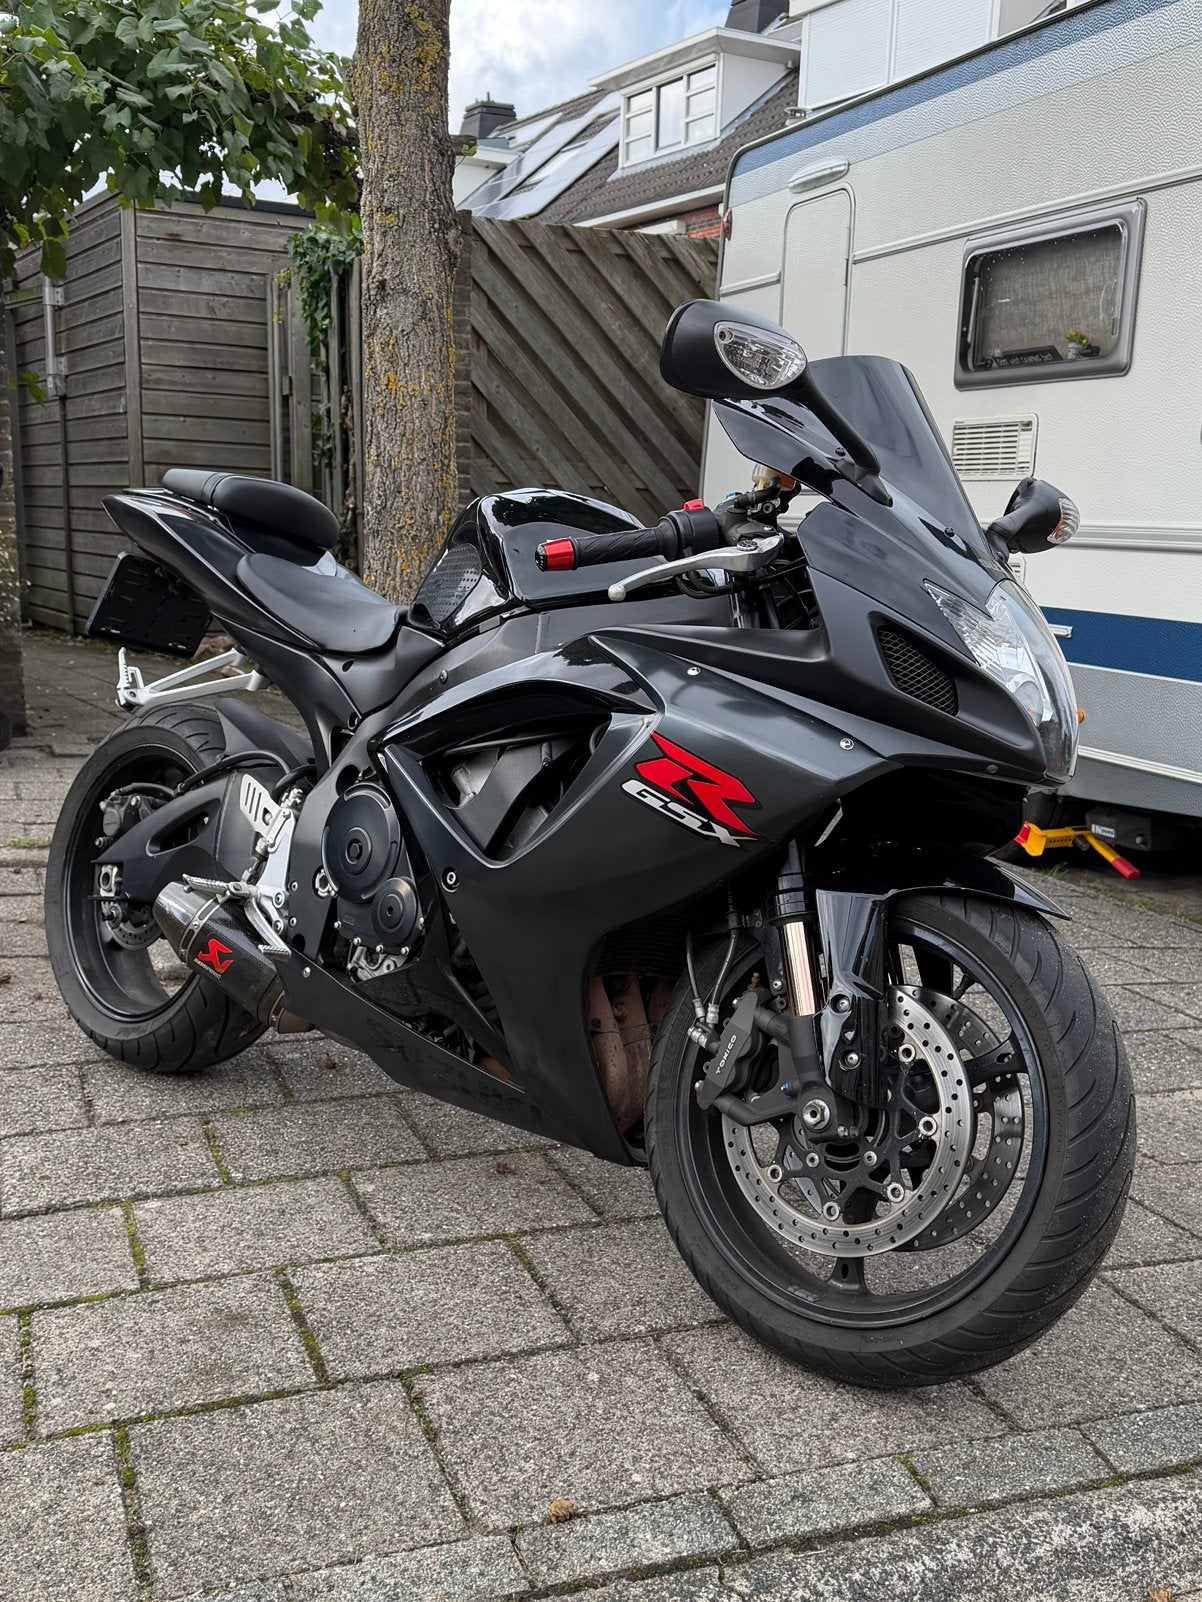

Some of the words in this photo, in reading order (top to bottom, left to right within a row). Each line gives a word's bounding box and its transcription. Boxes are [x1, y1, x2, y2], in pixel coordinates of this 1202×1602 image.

[621, 779, 758, 847] GSX
[636, 731, 760, 837] R
[715, 1034, 737, 1076] TOKICO
